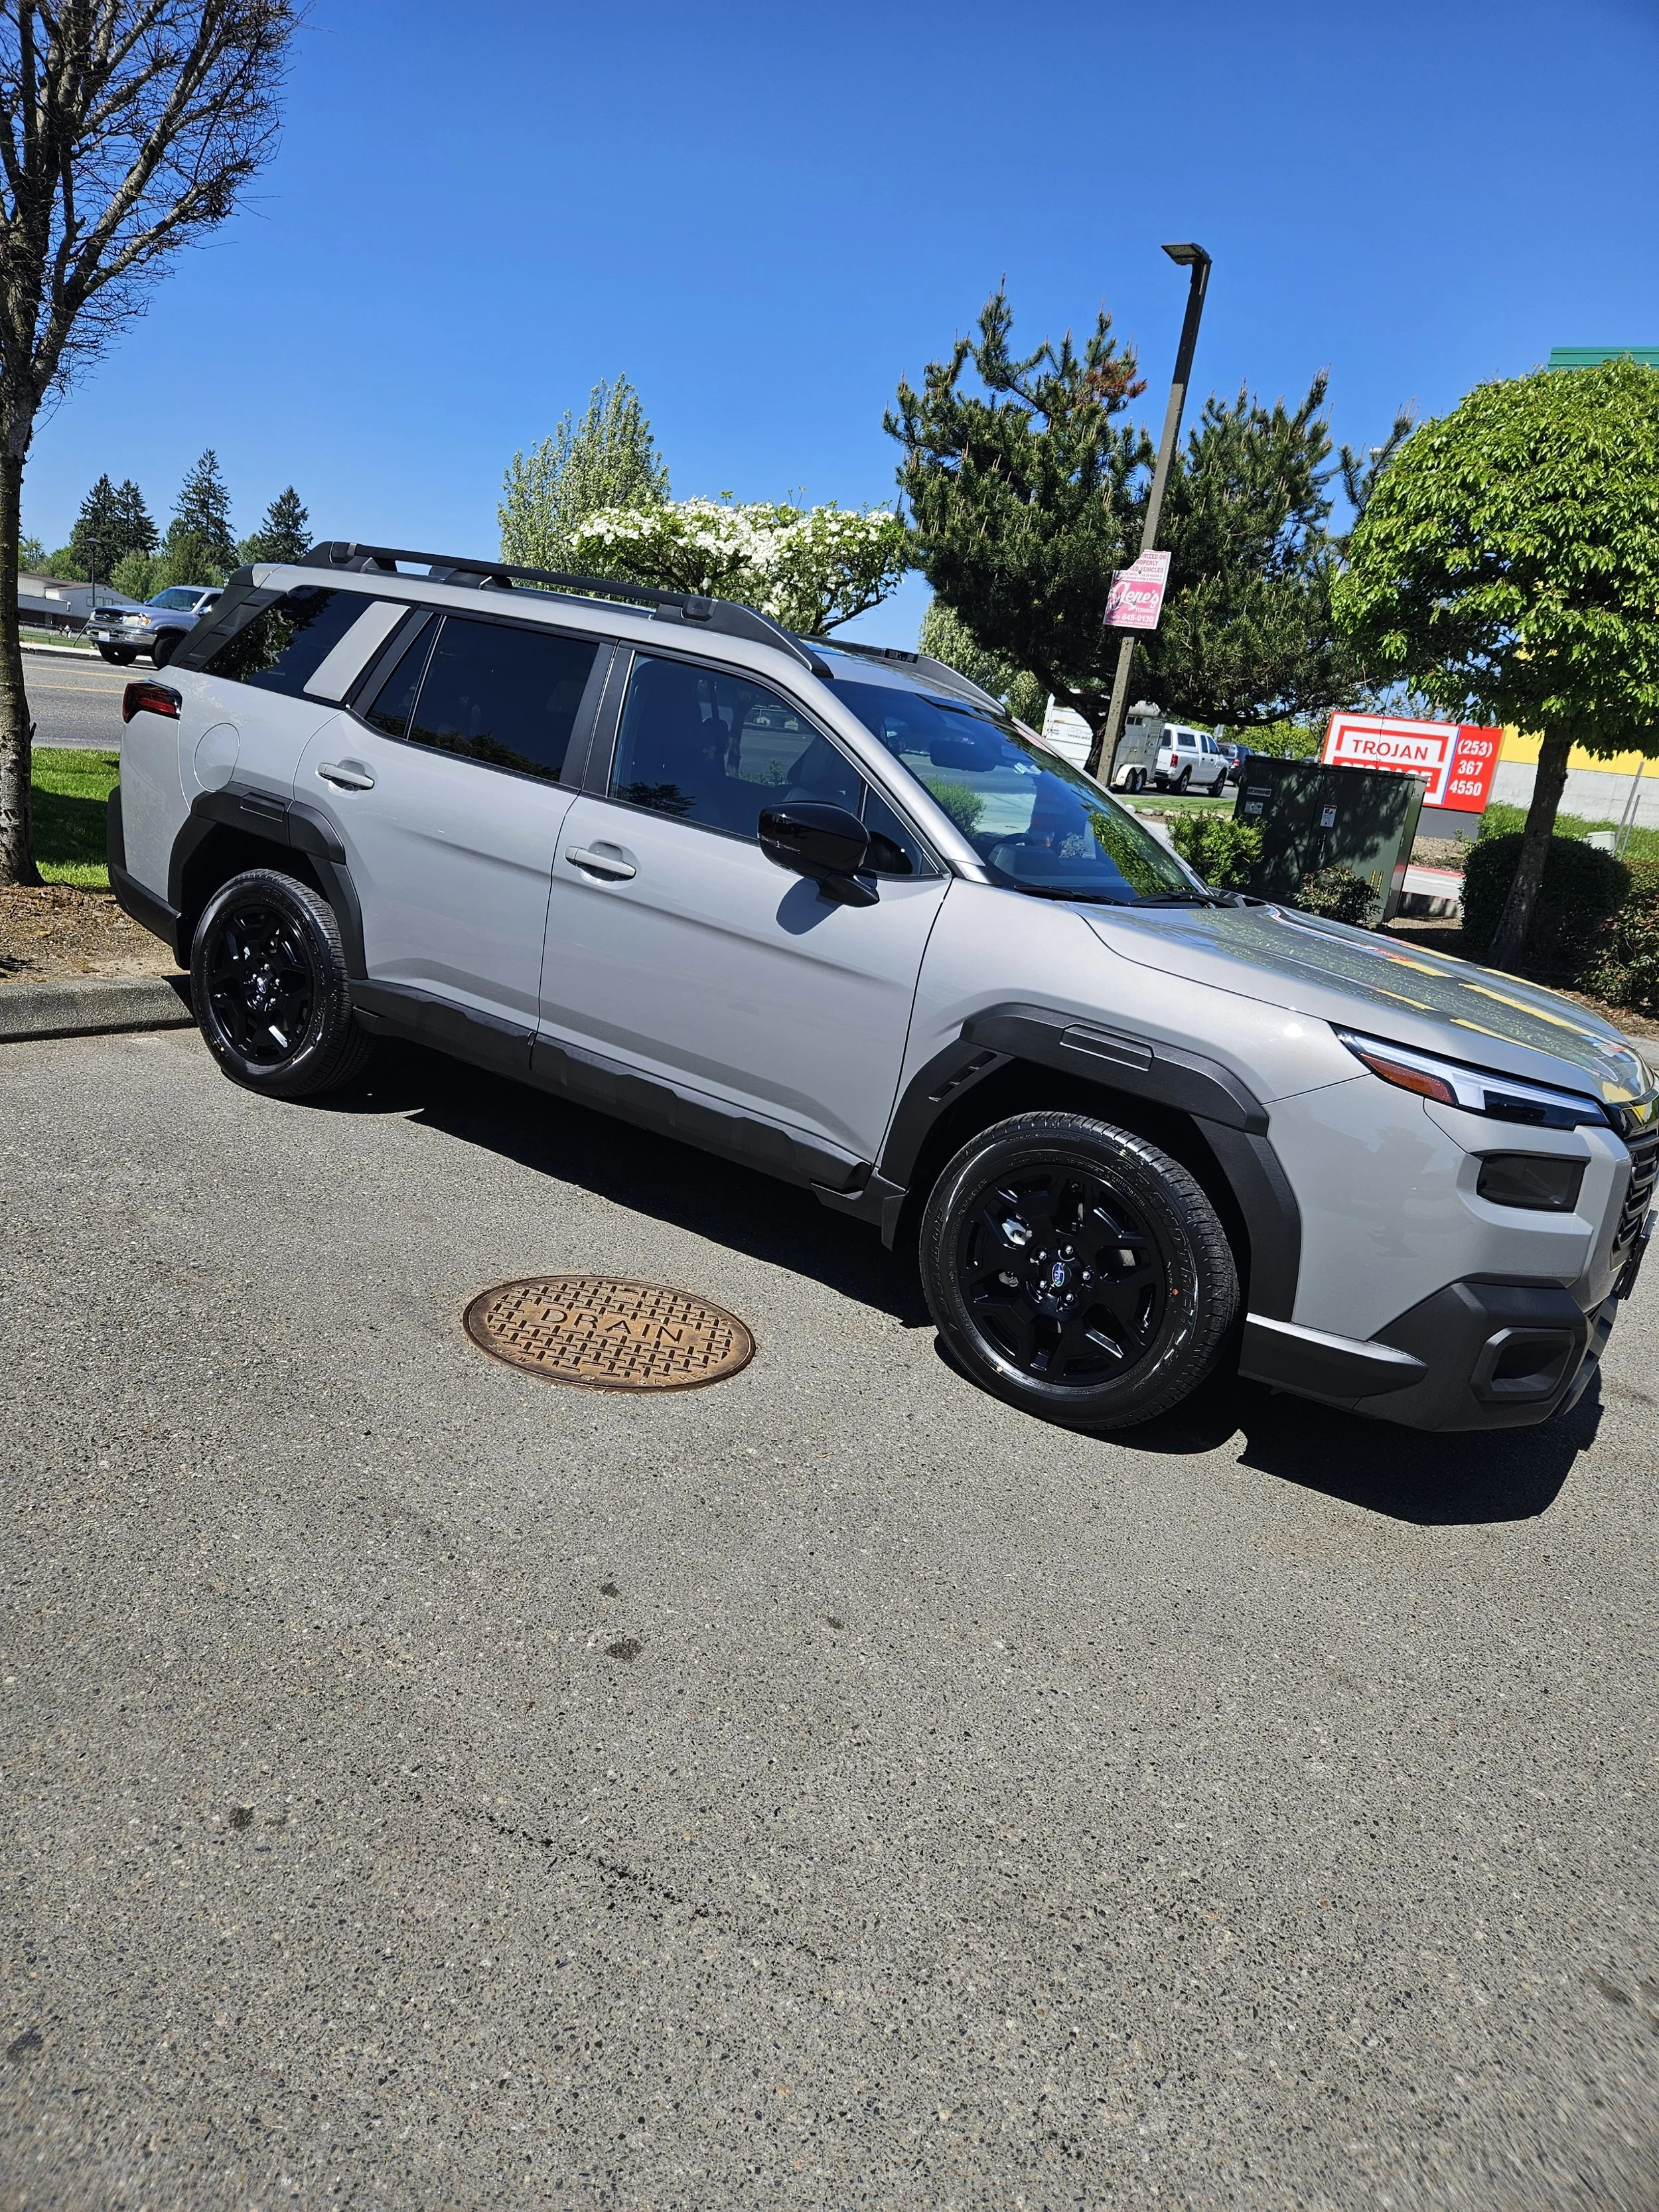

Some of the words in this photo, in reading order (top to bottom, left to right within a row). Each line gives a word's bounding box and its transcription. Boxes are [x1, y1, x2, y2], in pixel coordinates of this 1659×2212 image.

[1121, 613, 1154, 623] 845-0130
[1352, 739, 1429, 761] TROJAN
[1457, 739, 1493, 758] (253)
[1457, 759, 1484, 776] 367
[1449, 778, 1482, 796] 4550
[540, 1307, 684, 1344] DRAIN
